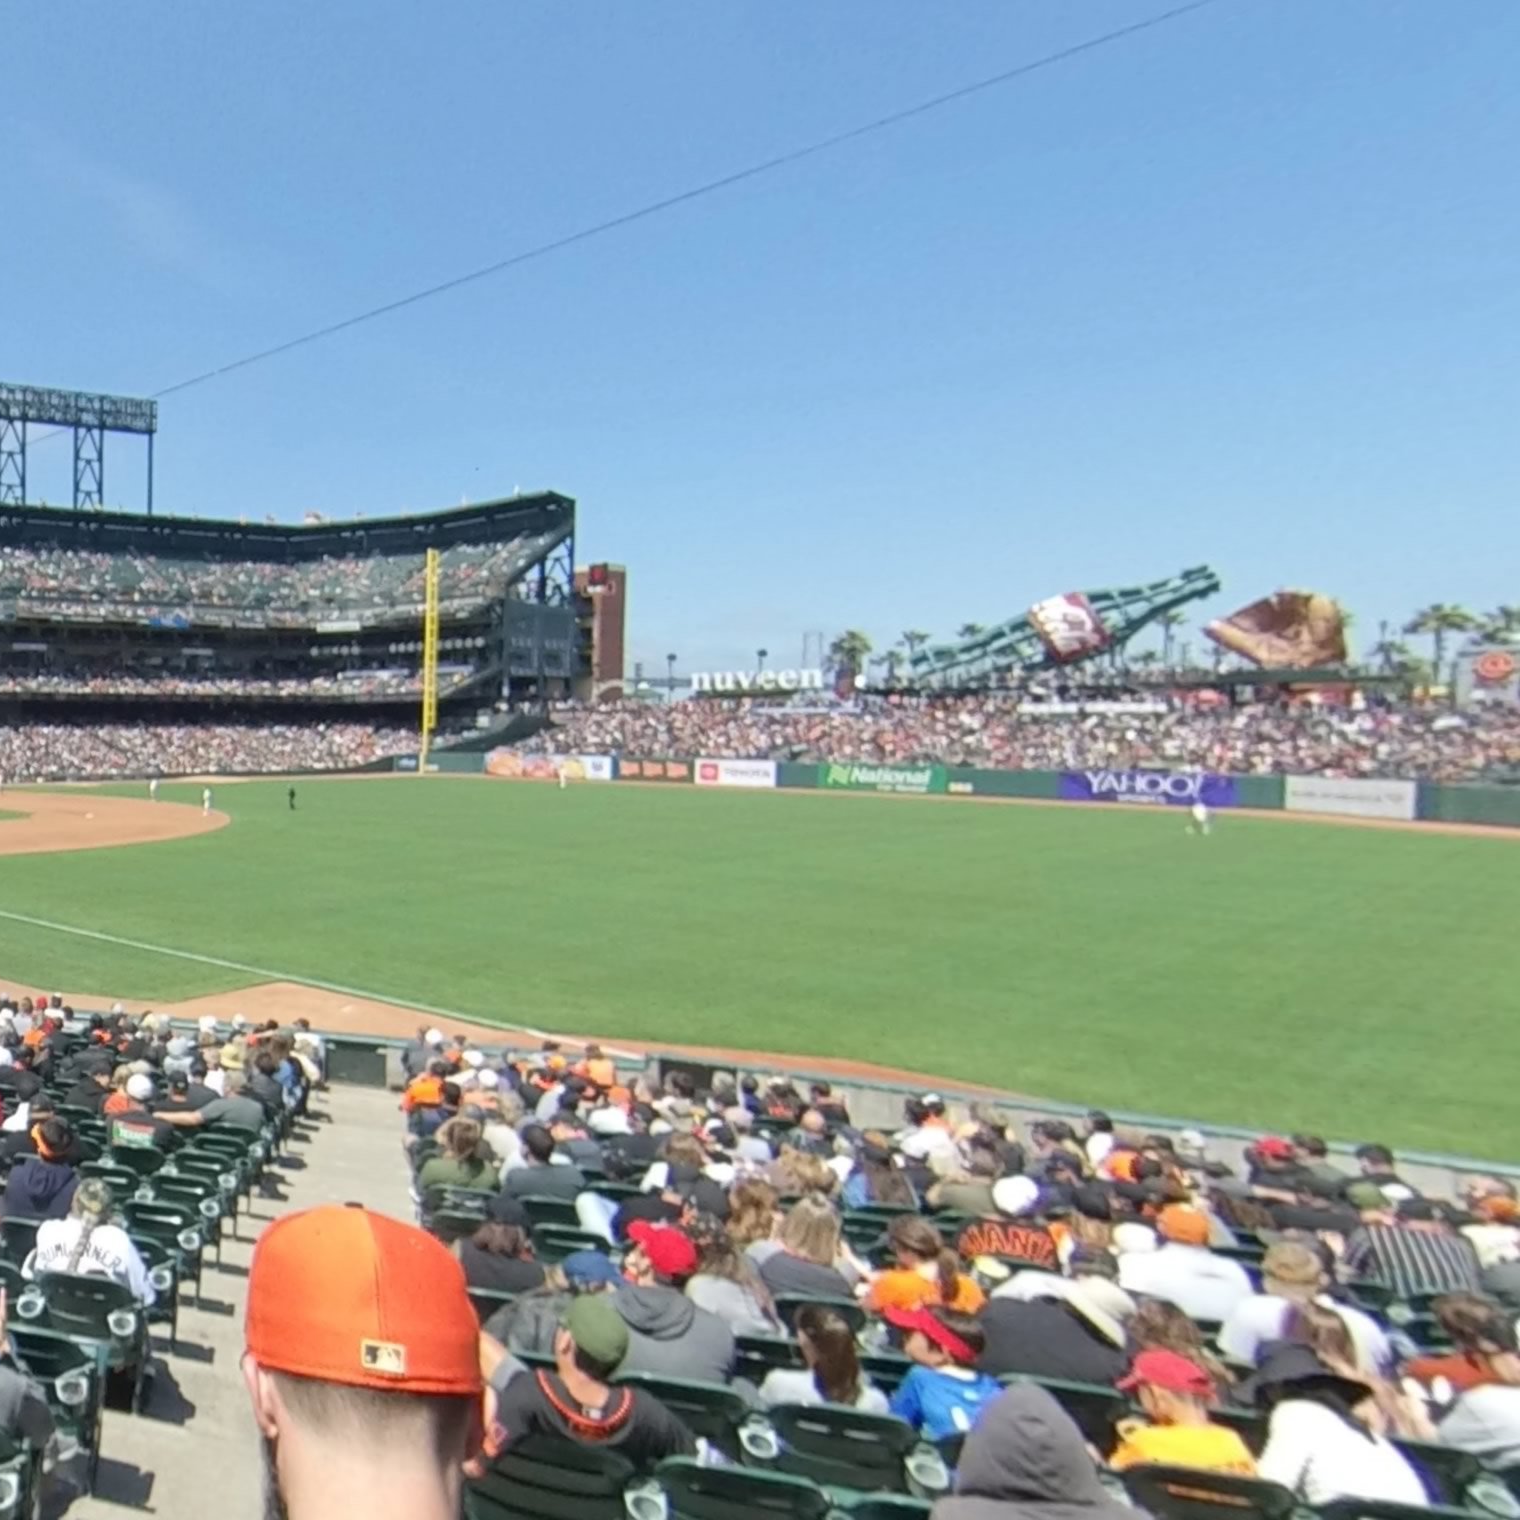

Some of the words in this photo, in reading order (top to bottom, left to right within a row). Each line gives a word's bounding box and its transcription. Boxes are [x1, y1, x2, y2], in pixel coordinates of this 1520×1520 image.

[691, 668, 823, 691] nuveen
[850, 767, 932, 784] National
[1084, 771, 1205, 799] YAHOO!
